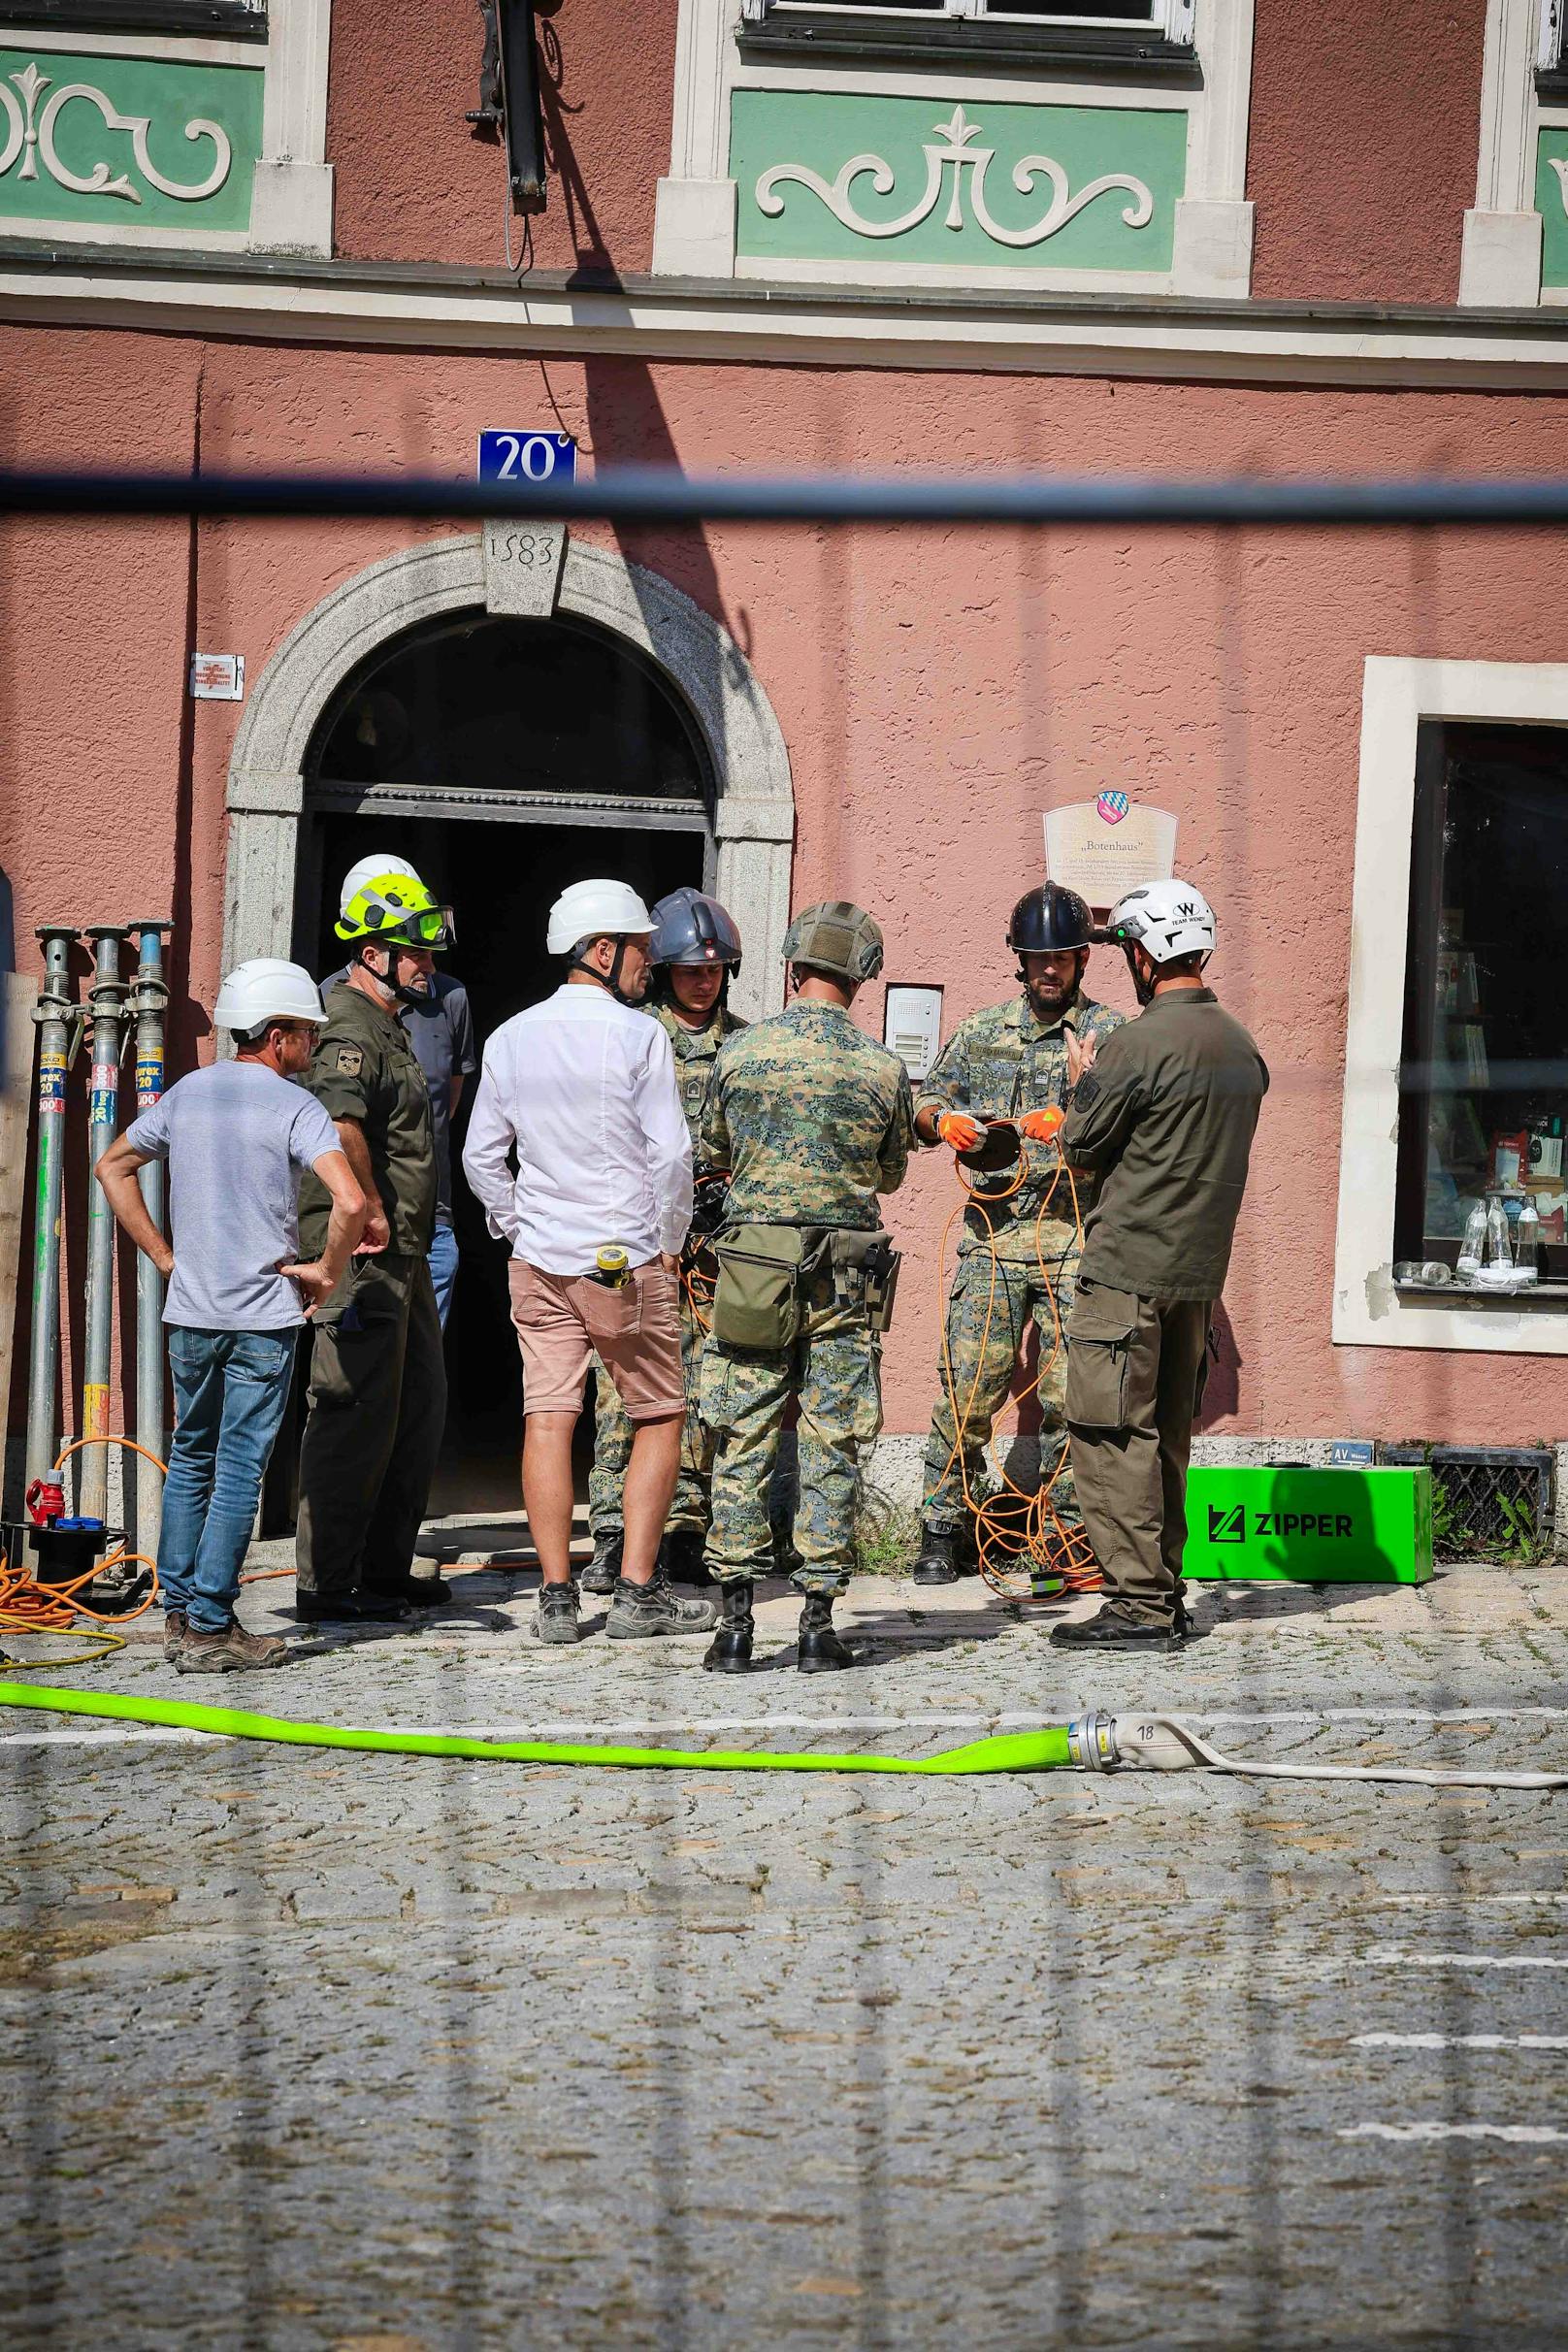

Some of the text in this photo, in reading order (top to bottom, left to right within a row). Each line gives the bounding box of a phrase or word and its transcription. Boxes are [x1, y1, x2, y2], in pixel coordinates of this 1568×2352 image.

[496, 435, 556, 481] 20
[491, 534, 554, 566] 1583
[40, 1073, 61, 1082] urex
[137, 1067, 159, 1076] urex
[41, 1082, 53, 1094] 20
[139, 1077, 152, 1088] 20
[95, 1106, 107, 1124] 20
[1334, 1448, 1348, 1459] AV
[1254, 1513, 1354, 1538] ZIPPER
[1136, 1725, 1154, 1741] 18
